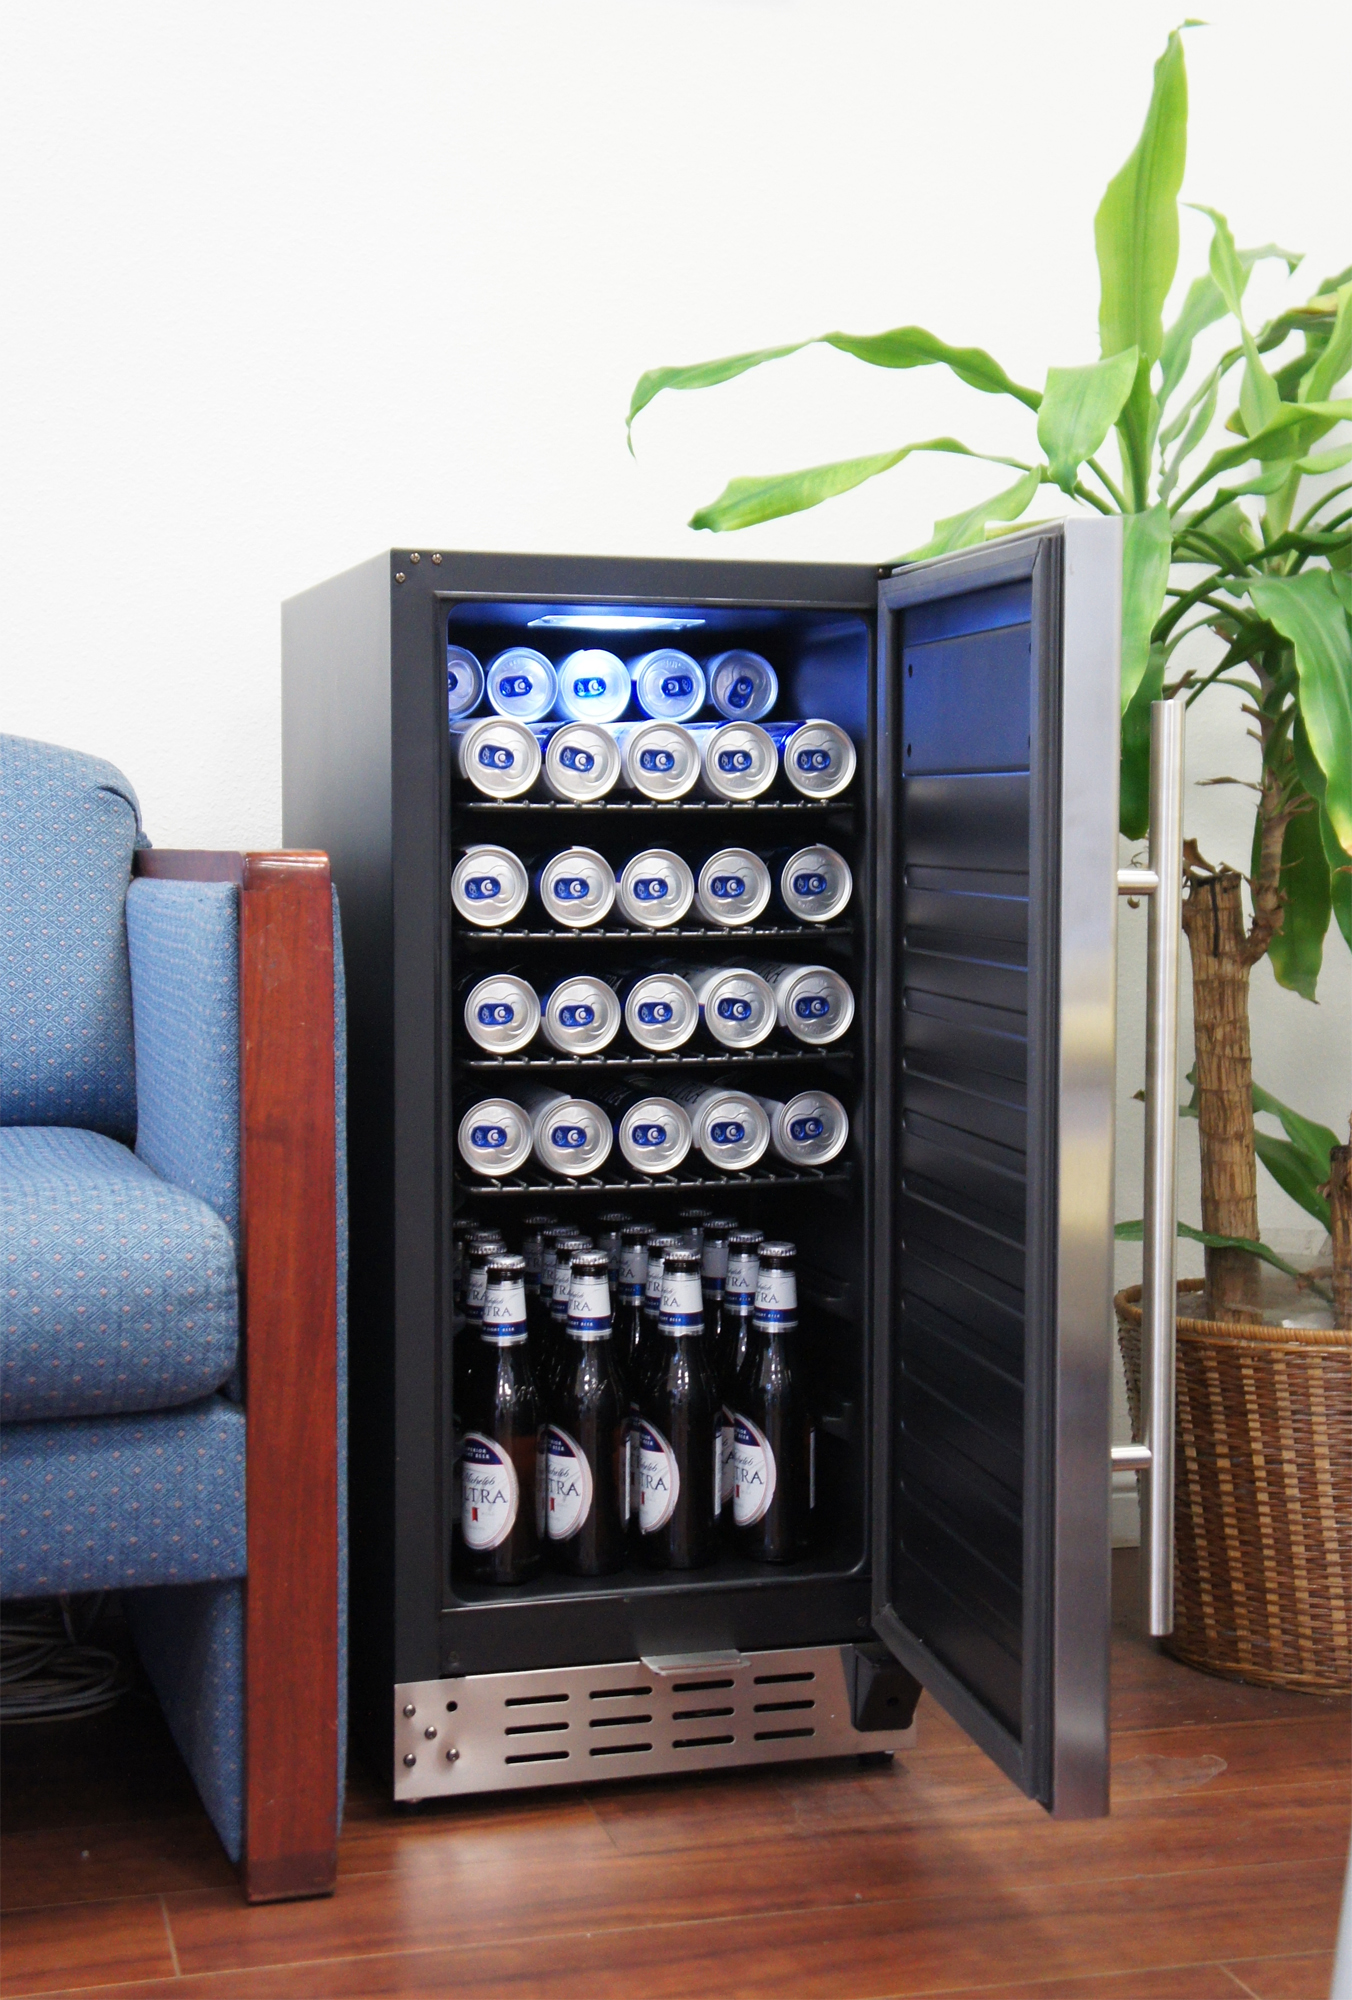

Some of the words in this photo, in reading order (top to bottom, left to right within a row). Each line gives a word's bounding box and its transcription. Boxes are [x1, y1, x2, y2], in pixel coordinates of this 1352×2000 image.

[727, 1276, 749, 1288] TRA
[756, 1292, 779, 1304] TRA
[485, 1305, 512, 1317] TRA
[569, 1300, 592, 1312] TRA
[640, 1472, 668, 1491] TRA
[735, 1466, 764, 1485] TRA
[463, 1485, 508, 1504] LTRA
[548, 1478, 580, 1497] TRA
